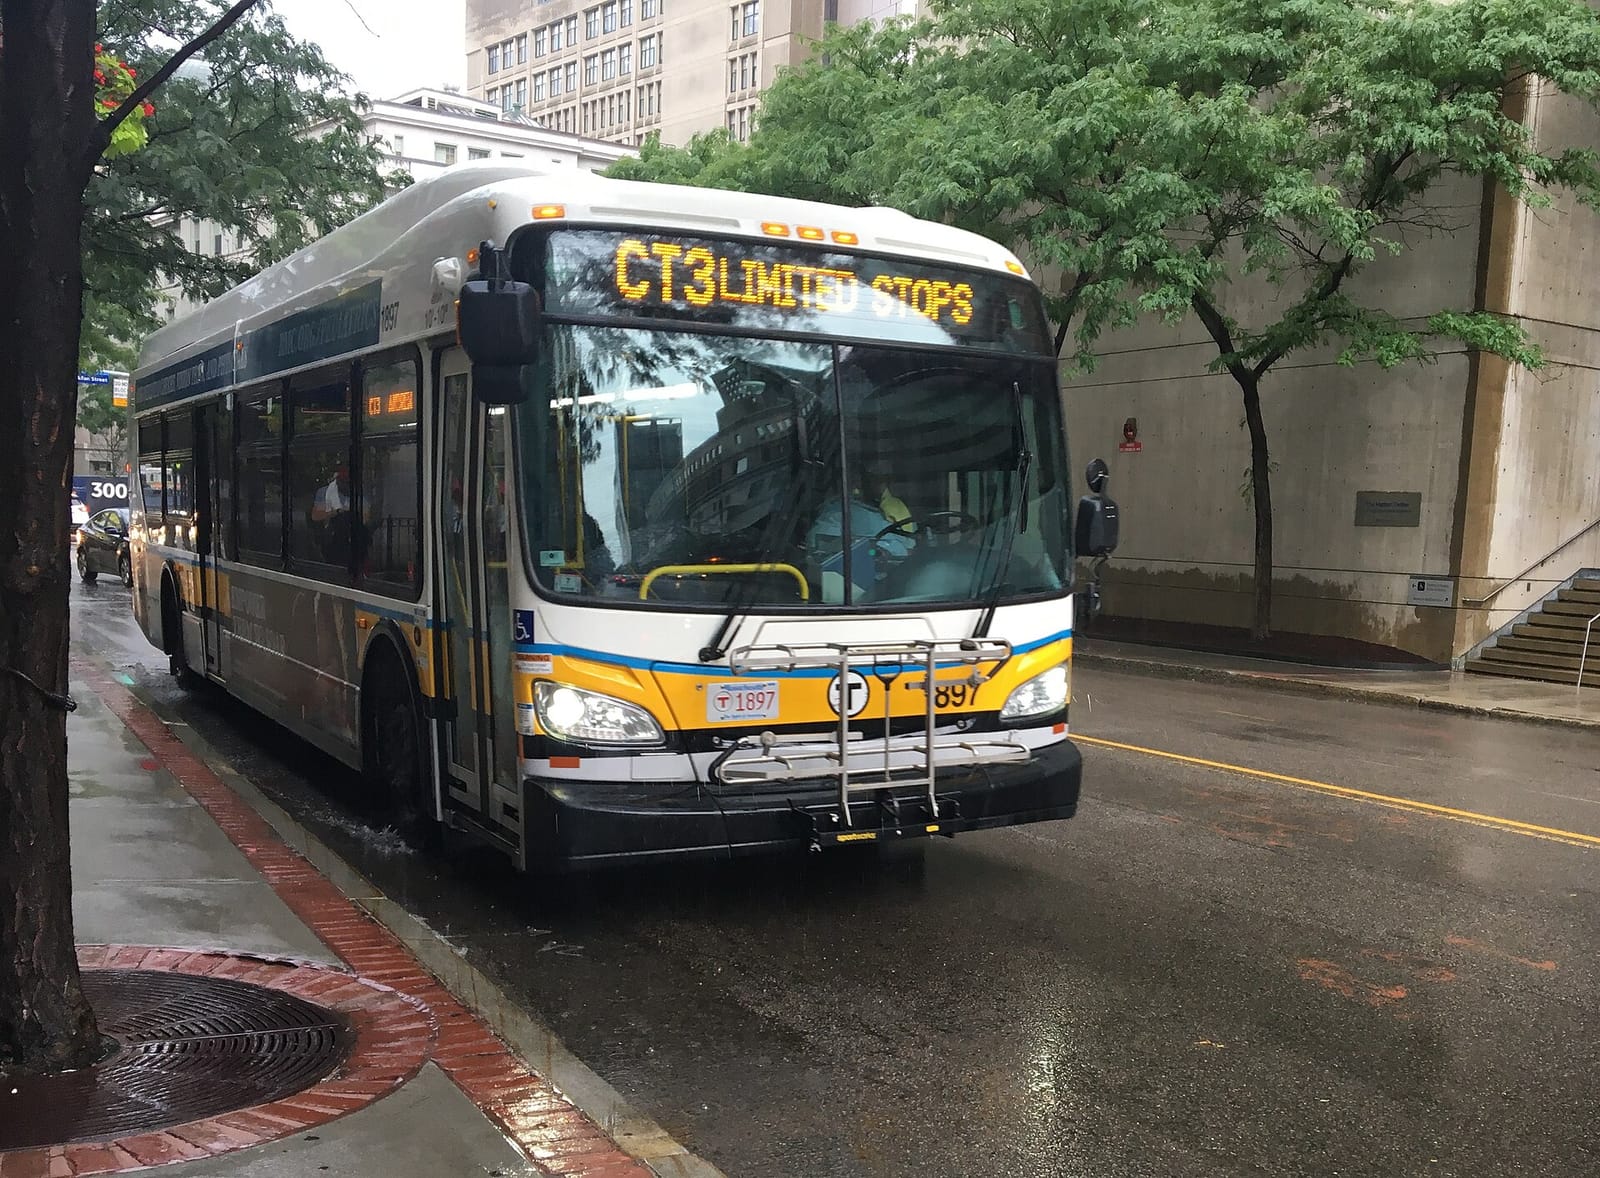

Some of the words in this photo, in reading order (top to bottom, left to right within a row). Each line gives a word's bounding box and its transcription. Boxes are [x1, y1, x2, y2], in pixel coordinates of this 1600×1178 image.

[616, 239, 716, 306] CT3
[719, 257, 858, 312] LIMITED
[871, 274, 974, 324] STOPS
[381, 301, 400, 332] 1897
[90, 481, 128, 499] 300
[736, 691, 775, 711] 1897
[934, 681, 981, 708] 897
